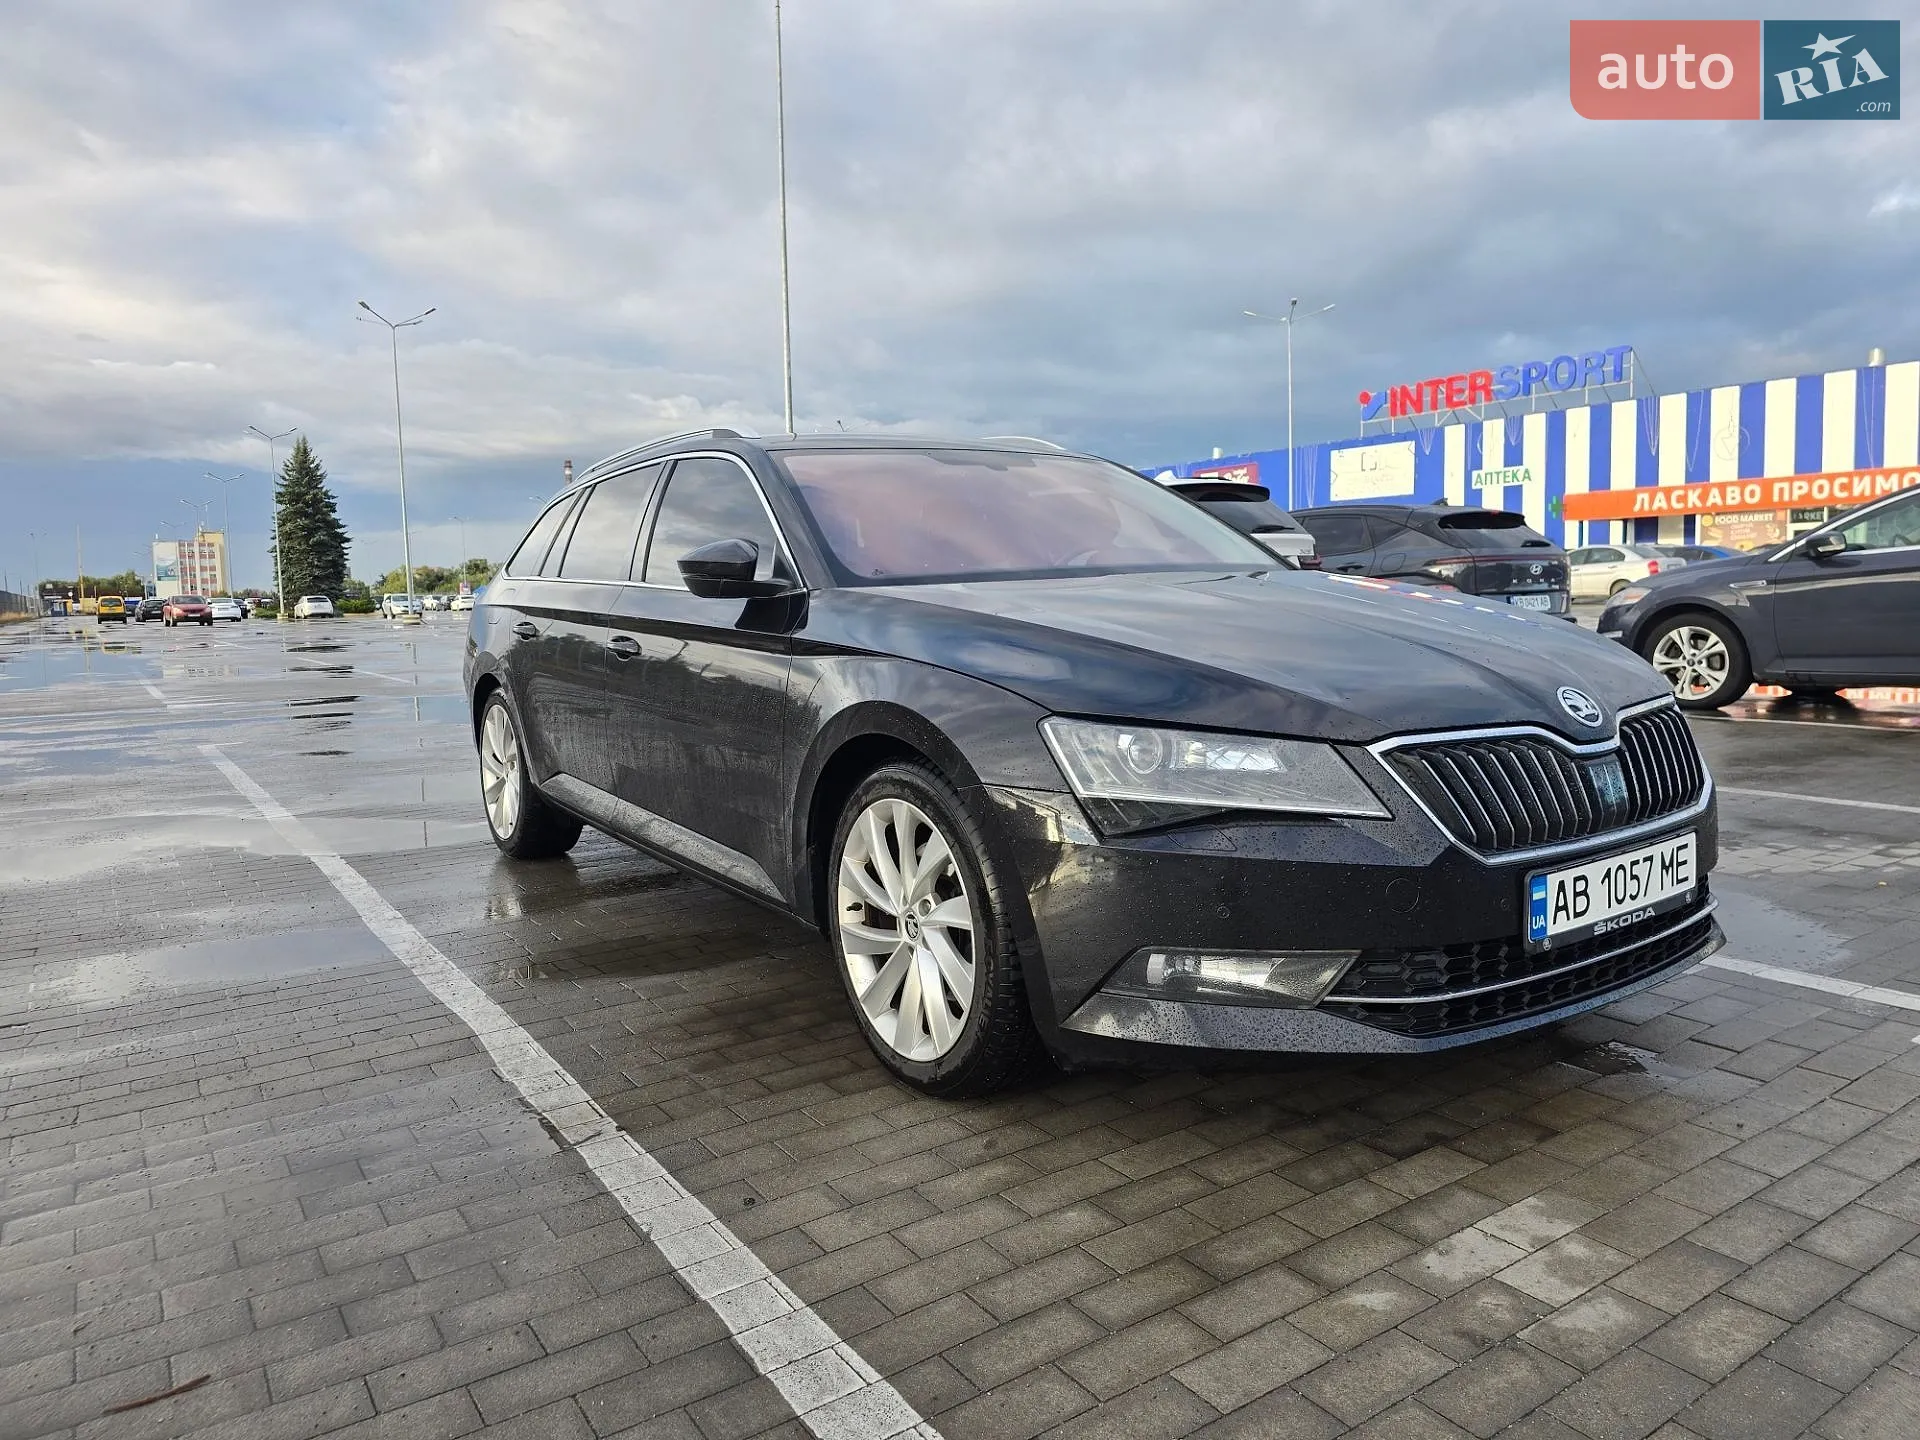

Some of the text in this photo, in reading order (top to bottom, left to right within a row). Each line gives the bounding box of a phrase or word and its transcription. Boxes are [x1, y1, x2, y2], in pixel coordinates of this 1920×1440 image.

[1388, 344, 1633, 417] INTERSPORT
[1474, 468, 1532, 487] АПТЕКА
[1633, 484, 1762, 512] ЛАСКАВО
[1714, 513, 1774, 525] FOOD MARKET
[1553, 843, 1689, 925] AB 1057 ME
[1532, 914, 1546, 930] UA
